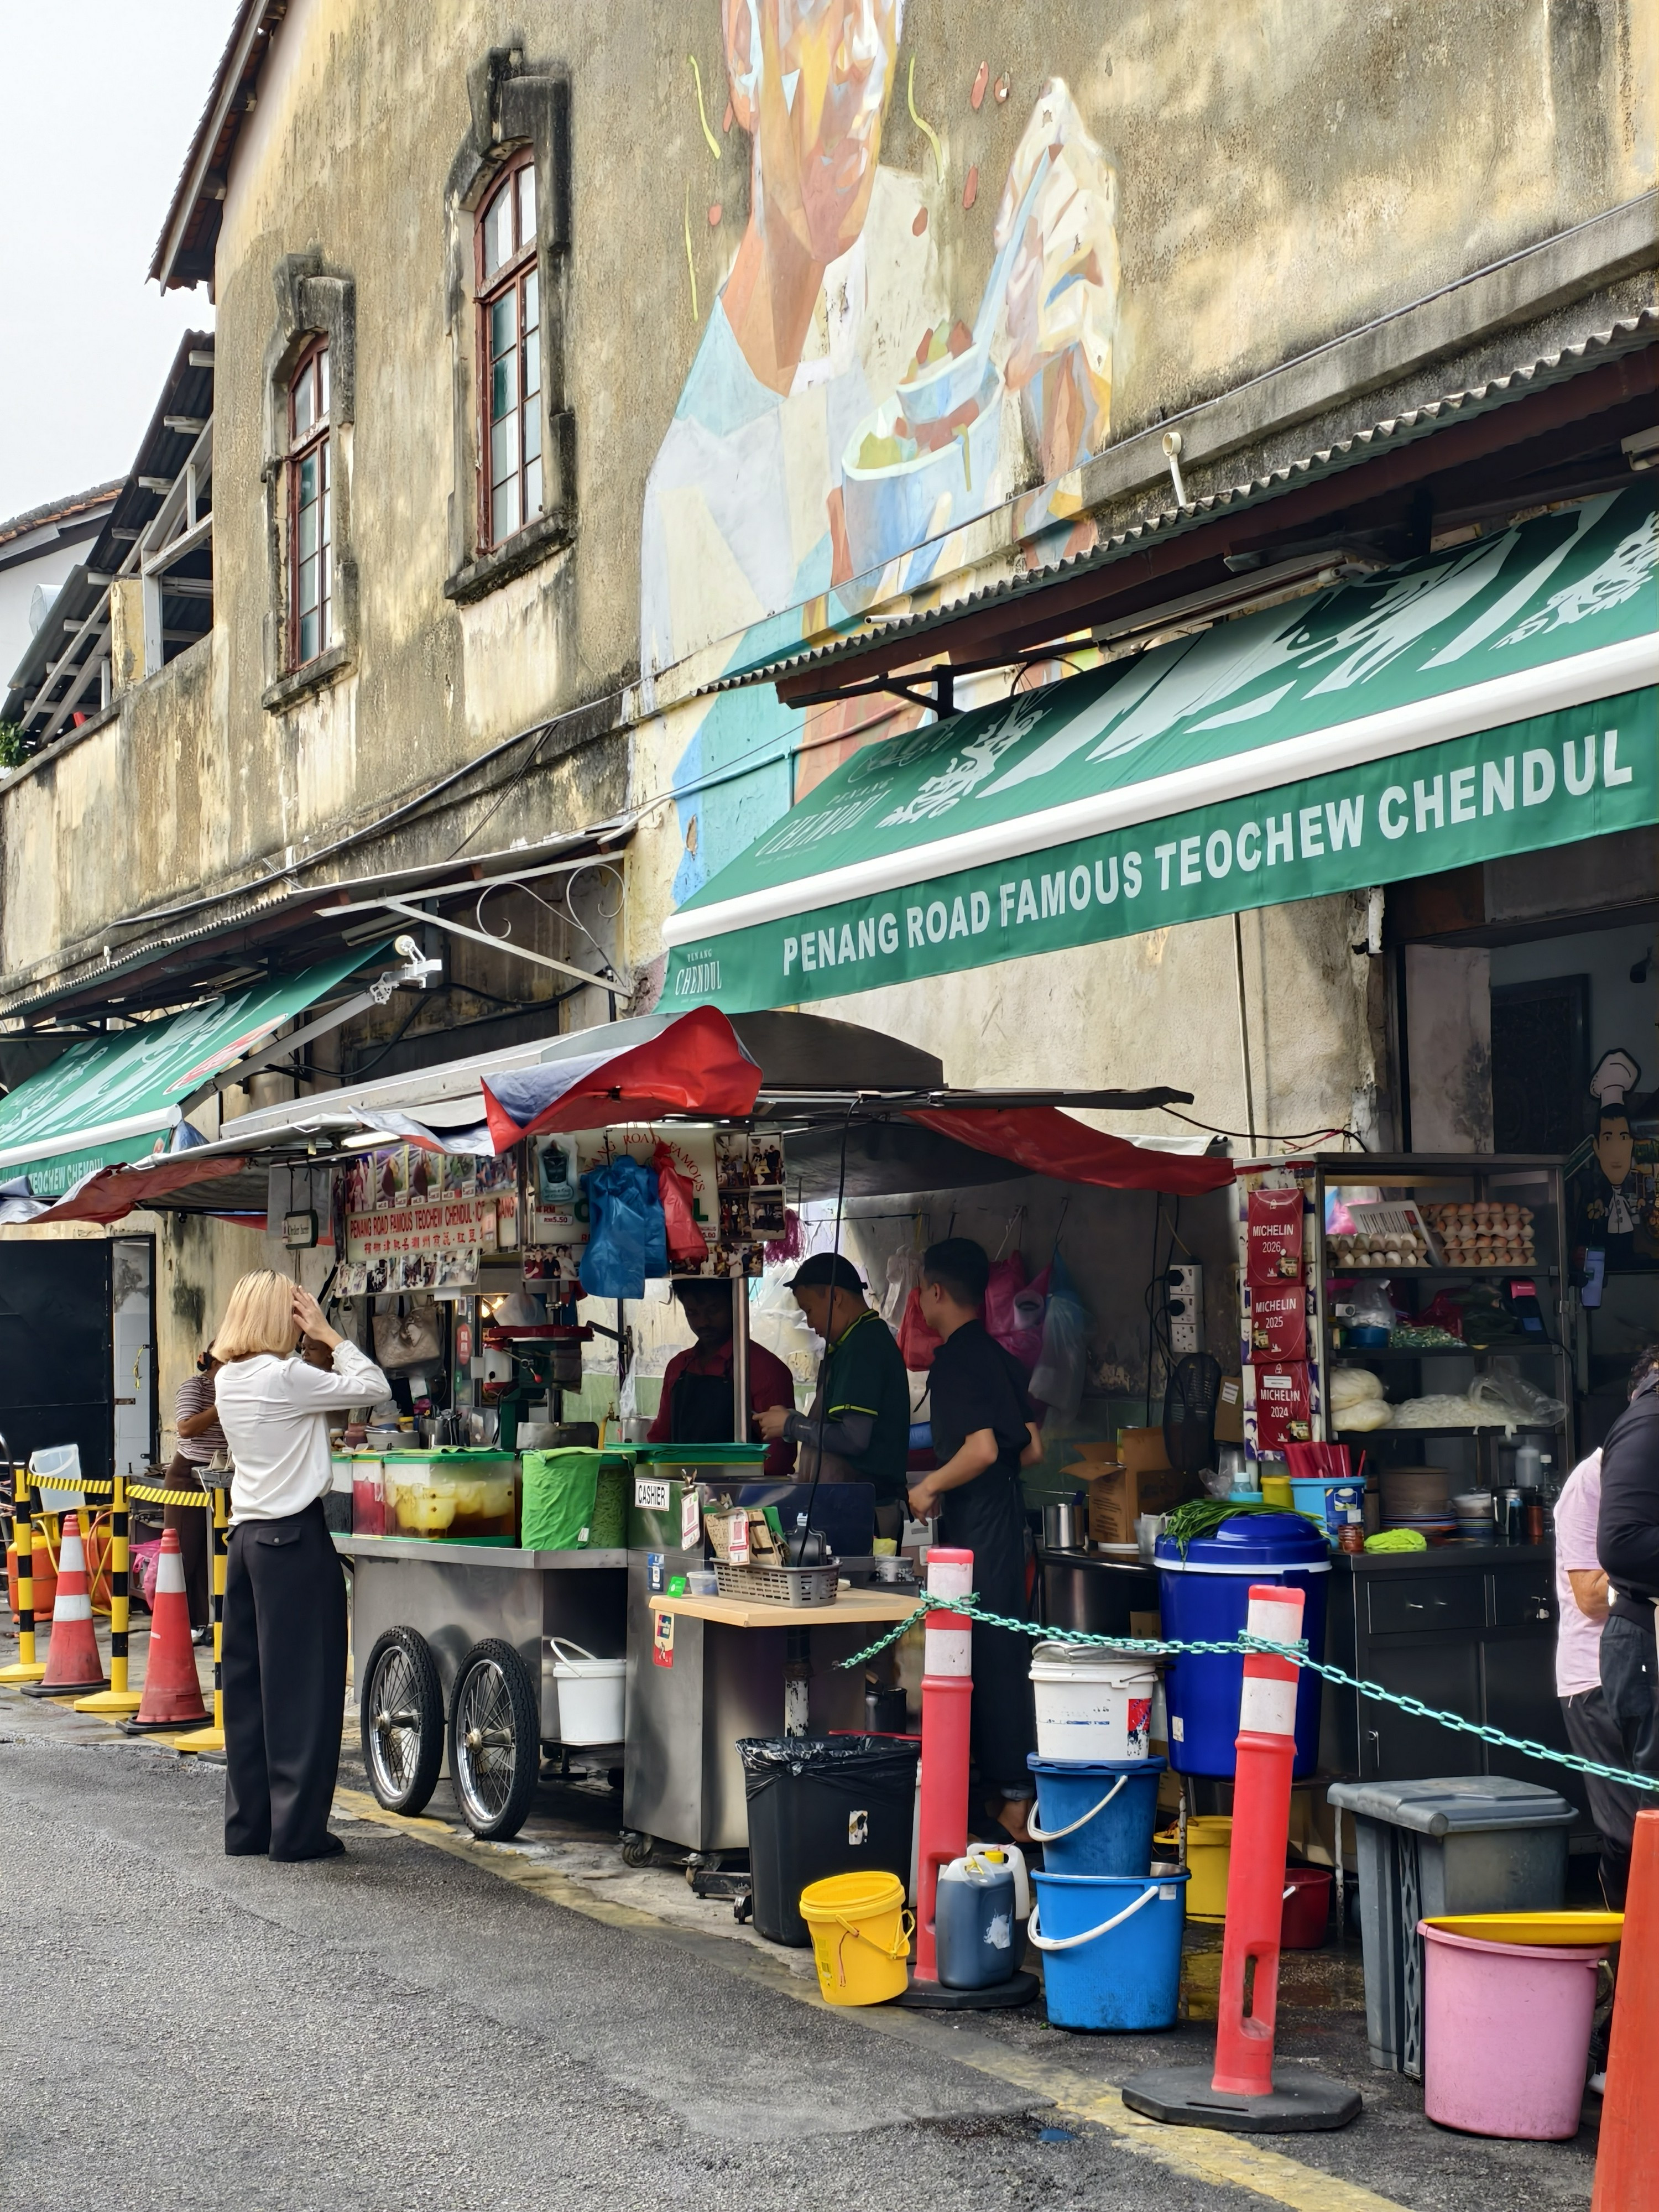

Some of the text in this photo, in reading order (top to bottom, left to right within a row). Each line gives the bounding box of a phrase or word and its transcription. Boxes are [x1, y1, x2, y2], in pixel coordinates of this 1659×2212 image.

[782, 729, 1633, 976] PENANG ROAD FAMOUS TEOCHEW CHENDUL
[687, 948, 712, 962] PENANG
[675, 961, 722, 996] CHENDUL
[350, 1217, 372, 1239] PENANG
[373, 1215, 388, 1235] ROAD
[390, 1211, 413, 1233] FAMOUS
[415, 1207, 442, 1230] TEOCHEW
[445, 1203, 472, 1226] CHENDUL
[1253, 1224, 1293, 1237] MICHELIN
[1262, 1241, 1281, 1253] 2026
[1255, 1298, 1296, 1313] MICHELIN
[1265, 1316, 1284, 1328] 2025
[1261, 1389, 1301, 1401] MICHELIN
[1271, 1406, 1288, 1418] 2024
[638, 1484, 665, 1507] CASHIER
